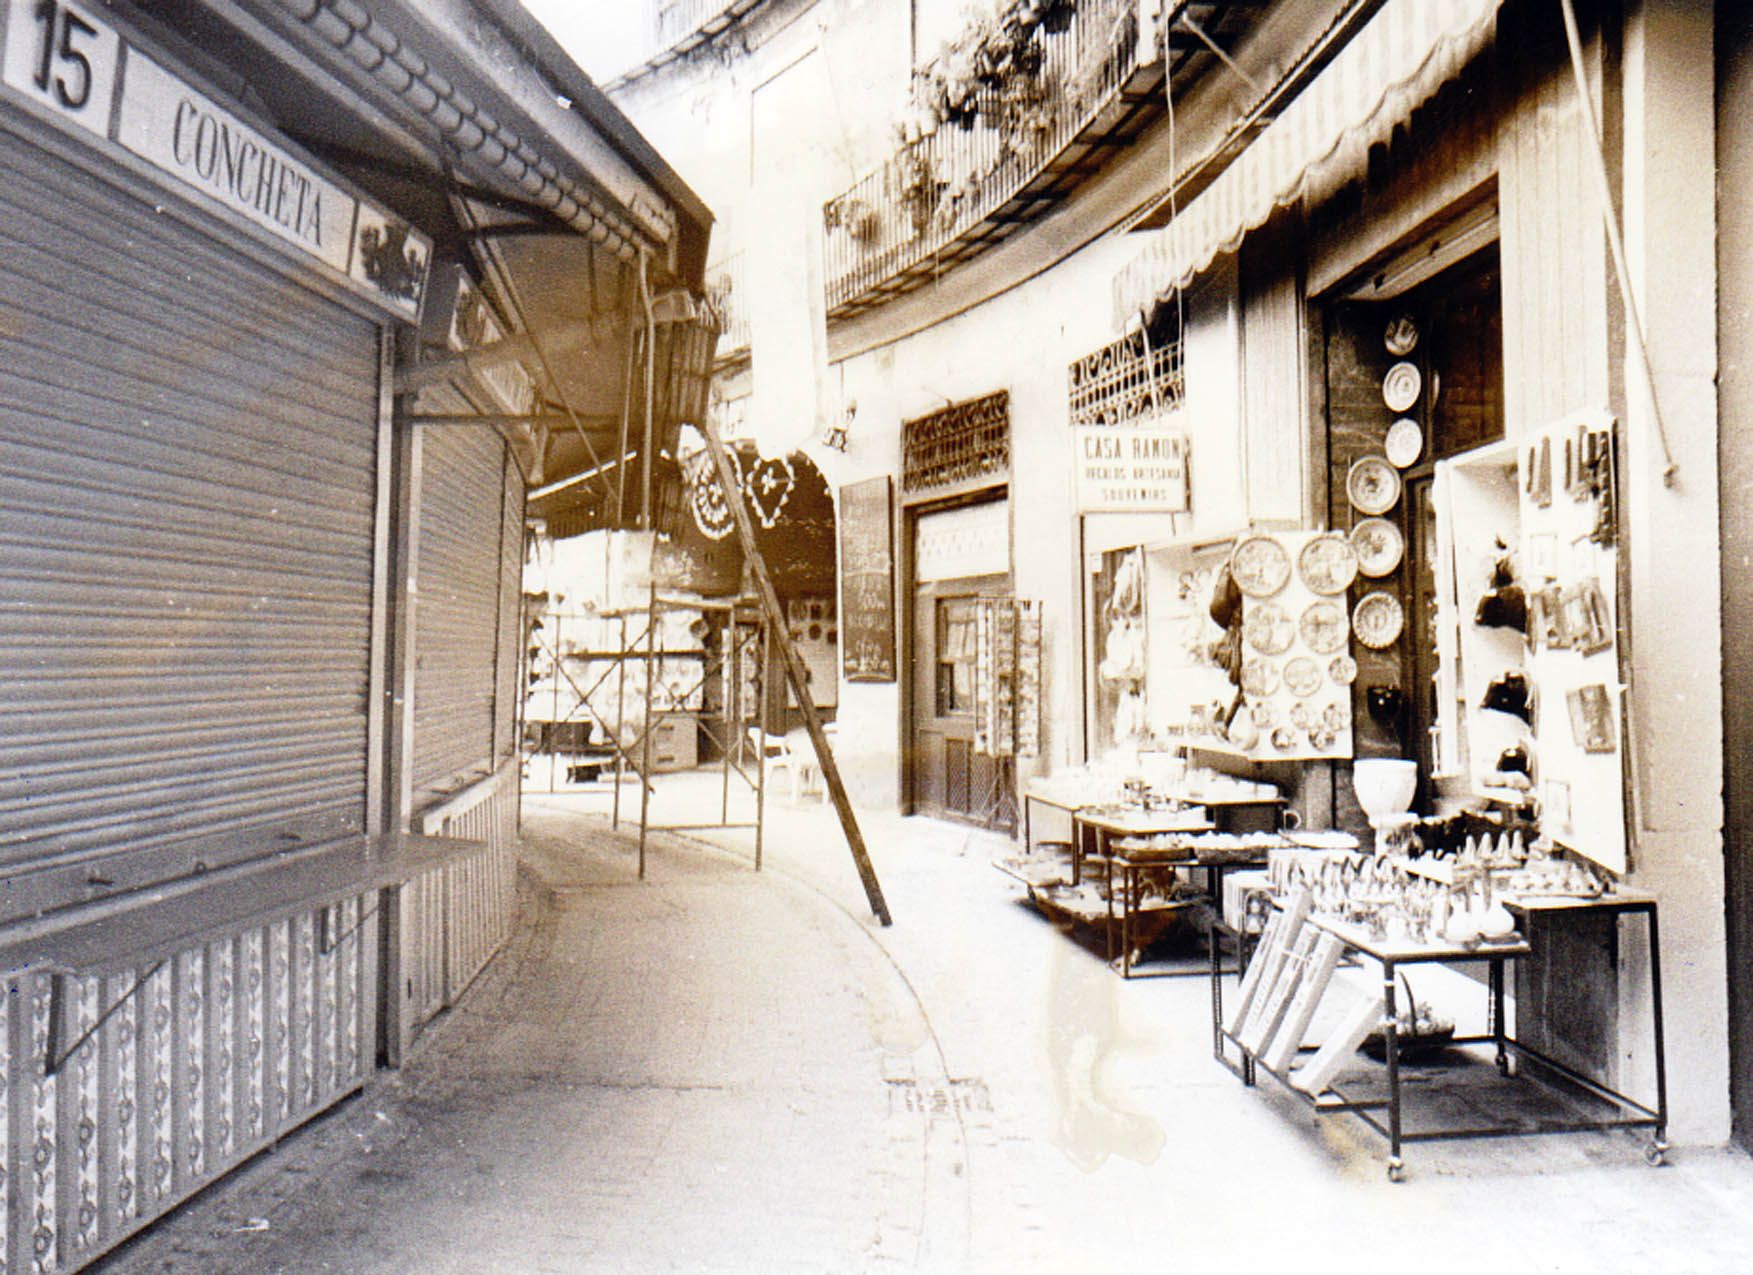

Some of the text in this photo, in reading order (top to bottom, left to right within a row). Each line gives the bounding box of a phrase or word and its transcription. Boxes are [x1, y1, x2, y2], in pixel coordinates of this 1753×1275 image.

[34, 0, 322, 248] 15 CONCHETA
[1084, 436, 1180, 459] CASA RAMON
[1086, 466, 1127, 479] REGALOS
[1102, 487, 1167, 501] SOUVENIRS
